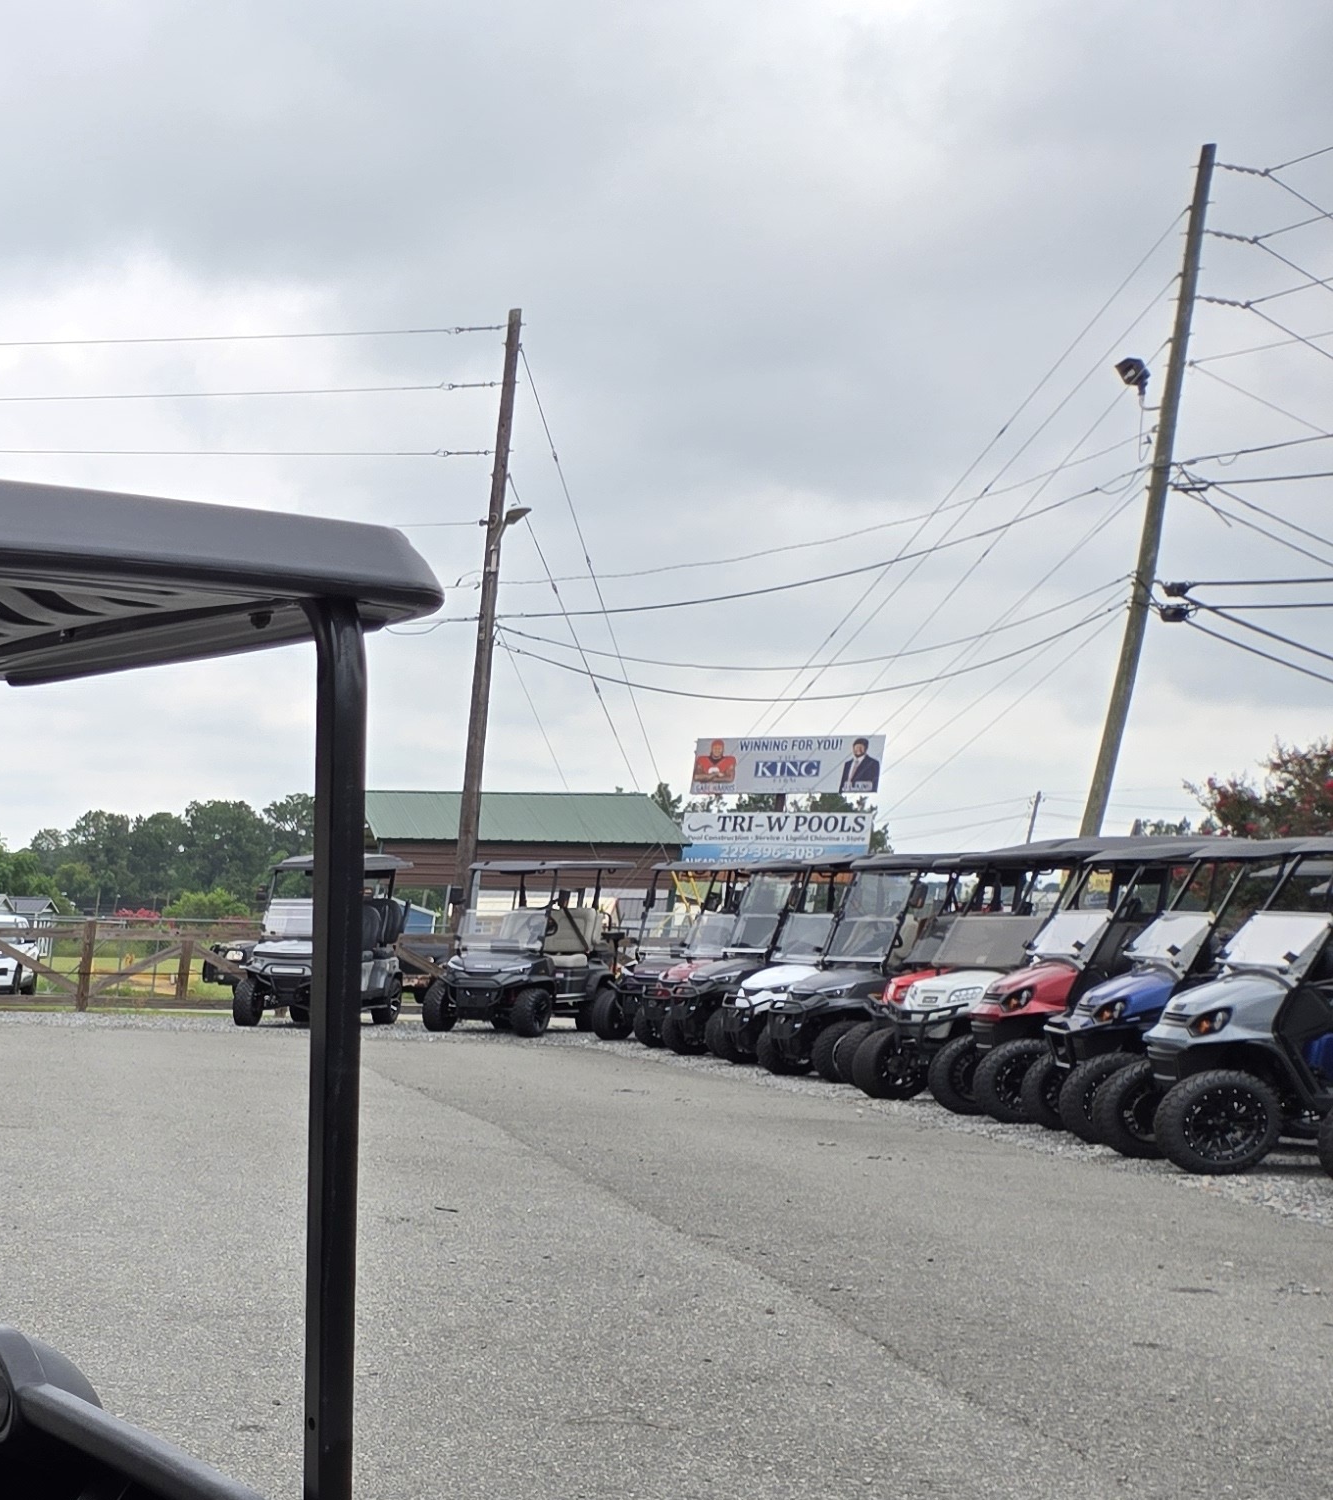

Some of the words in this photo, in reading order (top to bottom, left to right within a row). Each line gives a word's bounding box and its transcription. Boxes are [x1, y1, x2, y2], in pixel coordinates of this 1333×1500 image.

[740, 740, 789, 752] WINNING
[791, 739, 813, 751] FOR
[817, 739, 843, 751] YOU!
[756, 761, 818, 777] KING
[717, 815, 790, 833] TRI-W
[793, 815, 866, 833] POOLS
[786, 834, 809, 842] Liquid
[810, 834, 839, 842] Chlorine
[846, 834, 866, 842] Store
